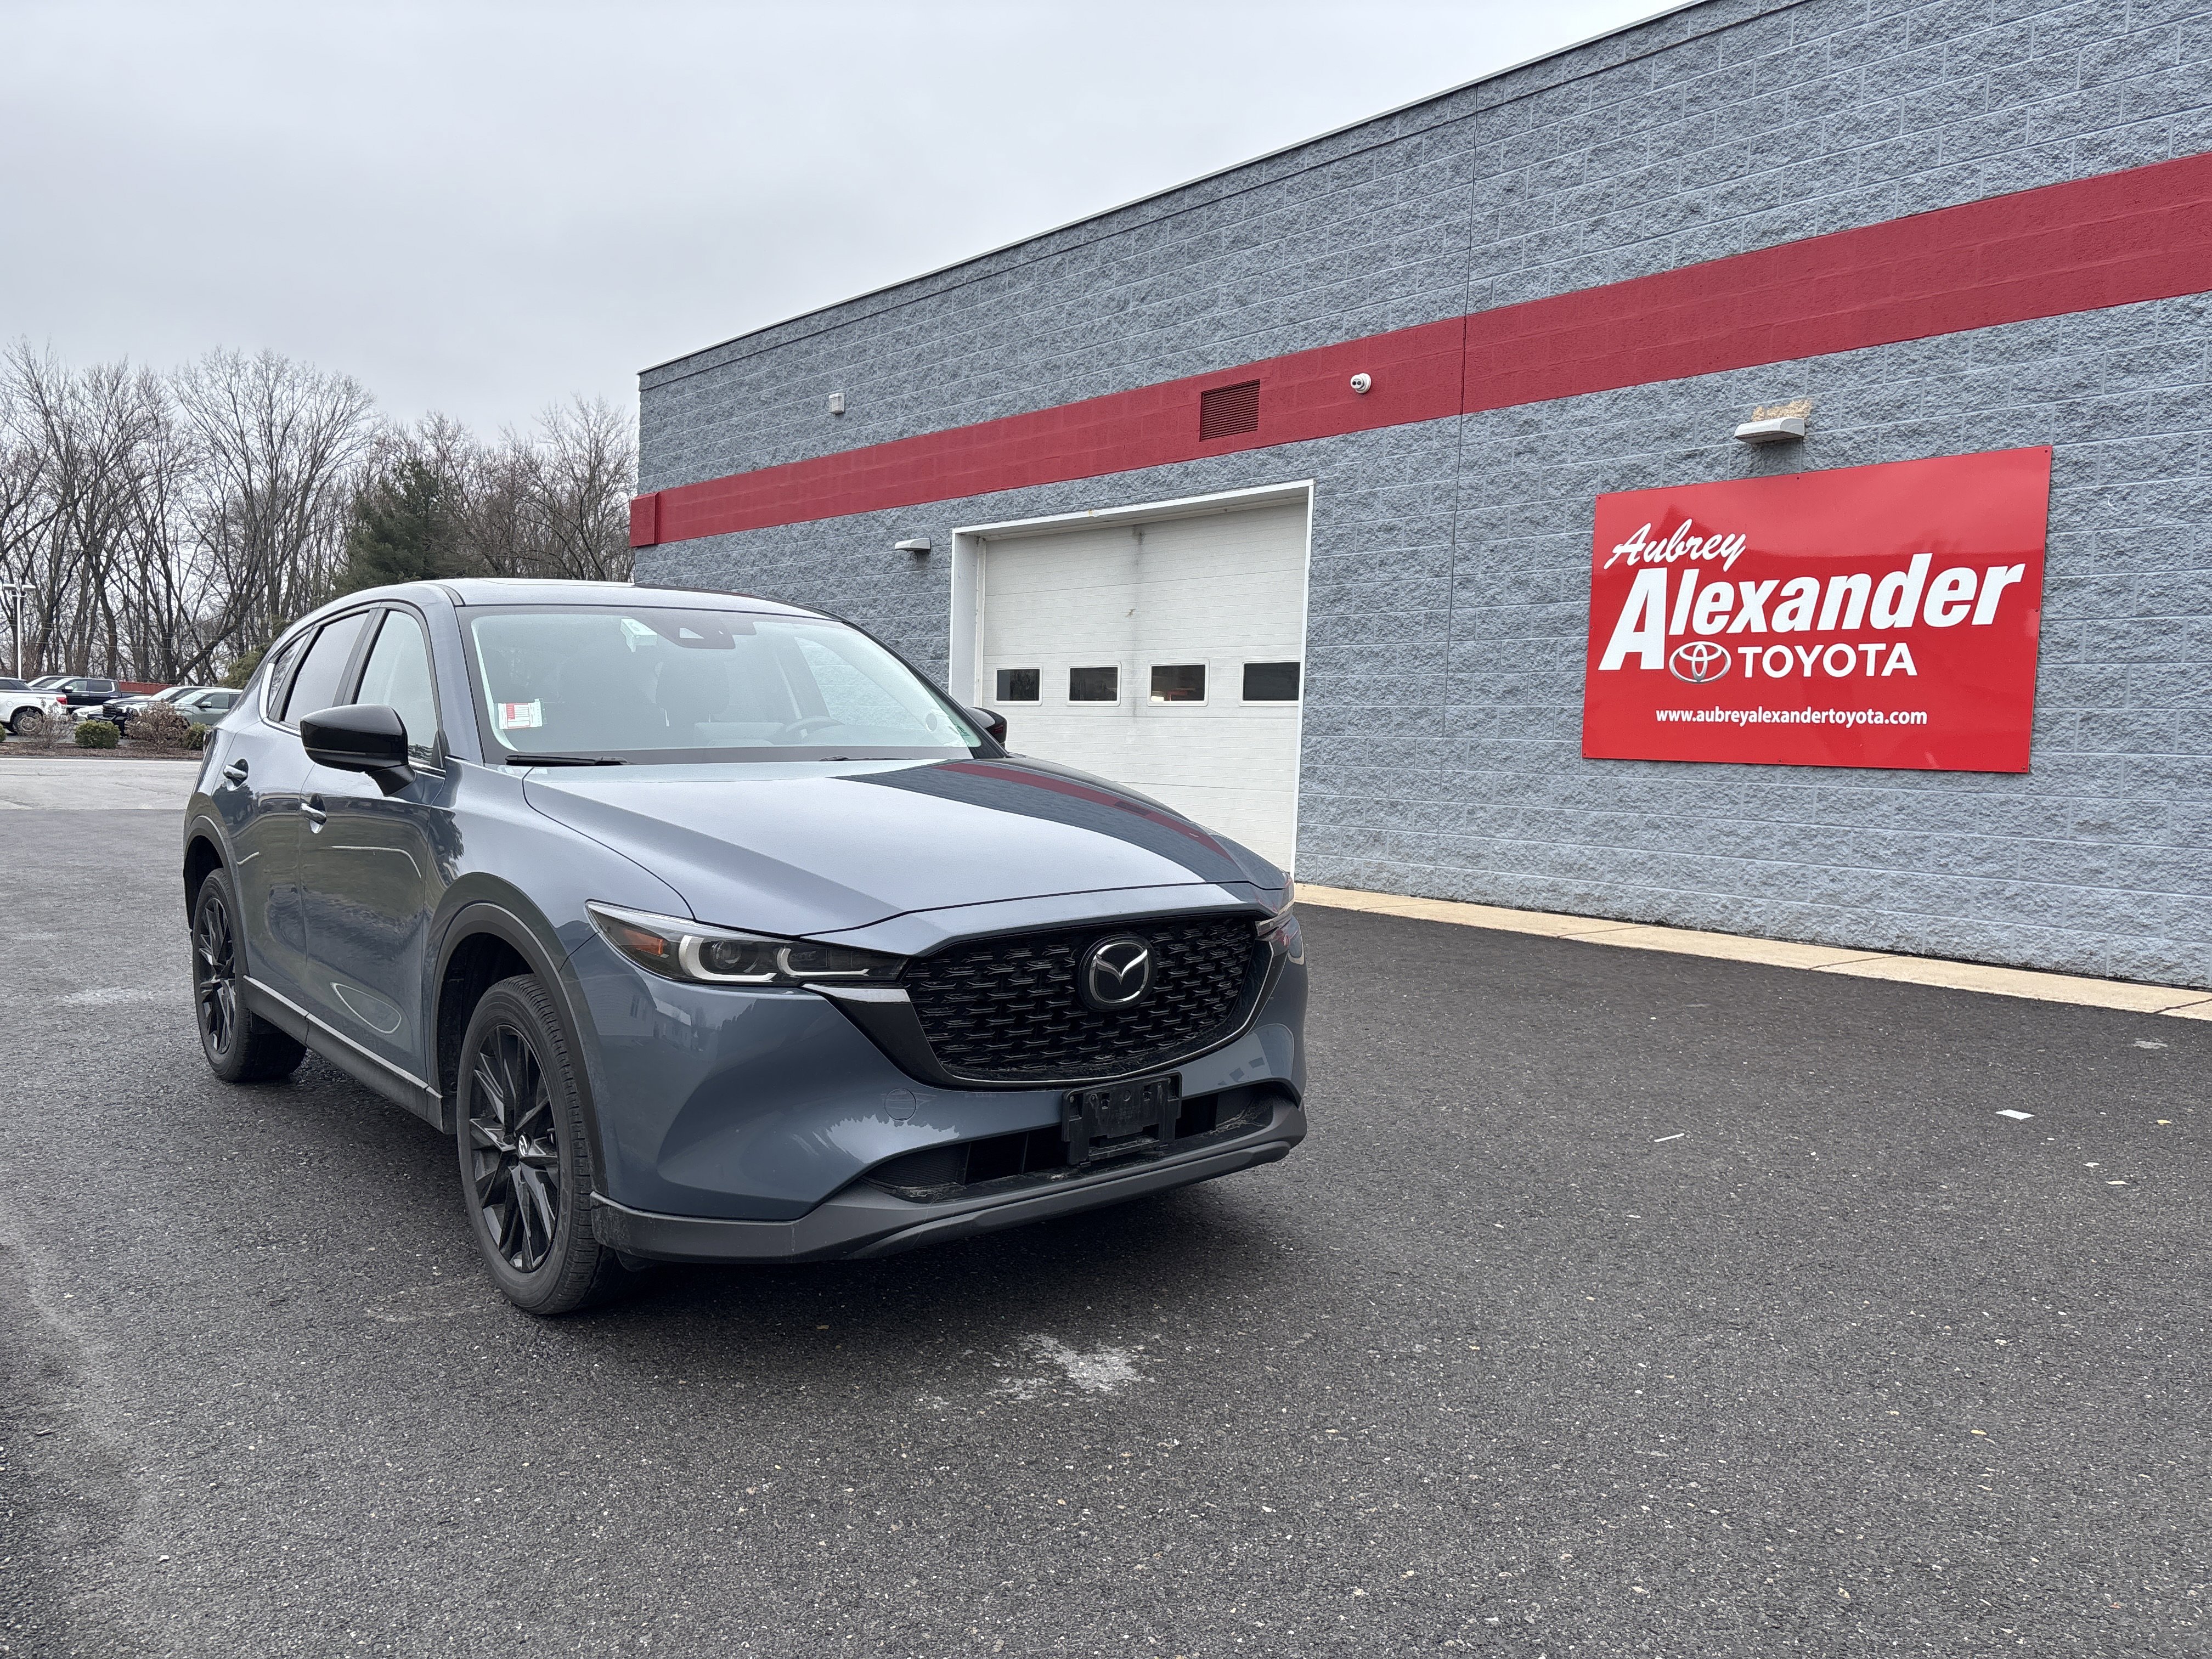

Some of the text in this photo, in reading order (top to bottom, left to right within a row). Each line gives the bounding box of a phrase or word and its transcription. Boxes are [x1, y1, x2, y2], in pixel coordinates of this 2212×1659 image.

[1603, 518, 1746, 572] Aubrey
[1597, 552, 2025, 670] Alexander
[1737, 642, 1917, 678] TOYOTA
[1656, 706, 1927, 729] www.aubreyalexandertoyota.com
